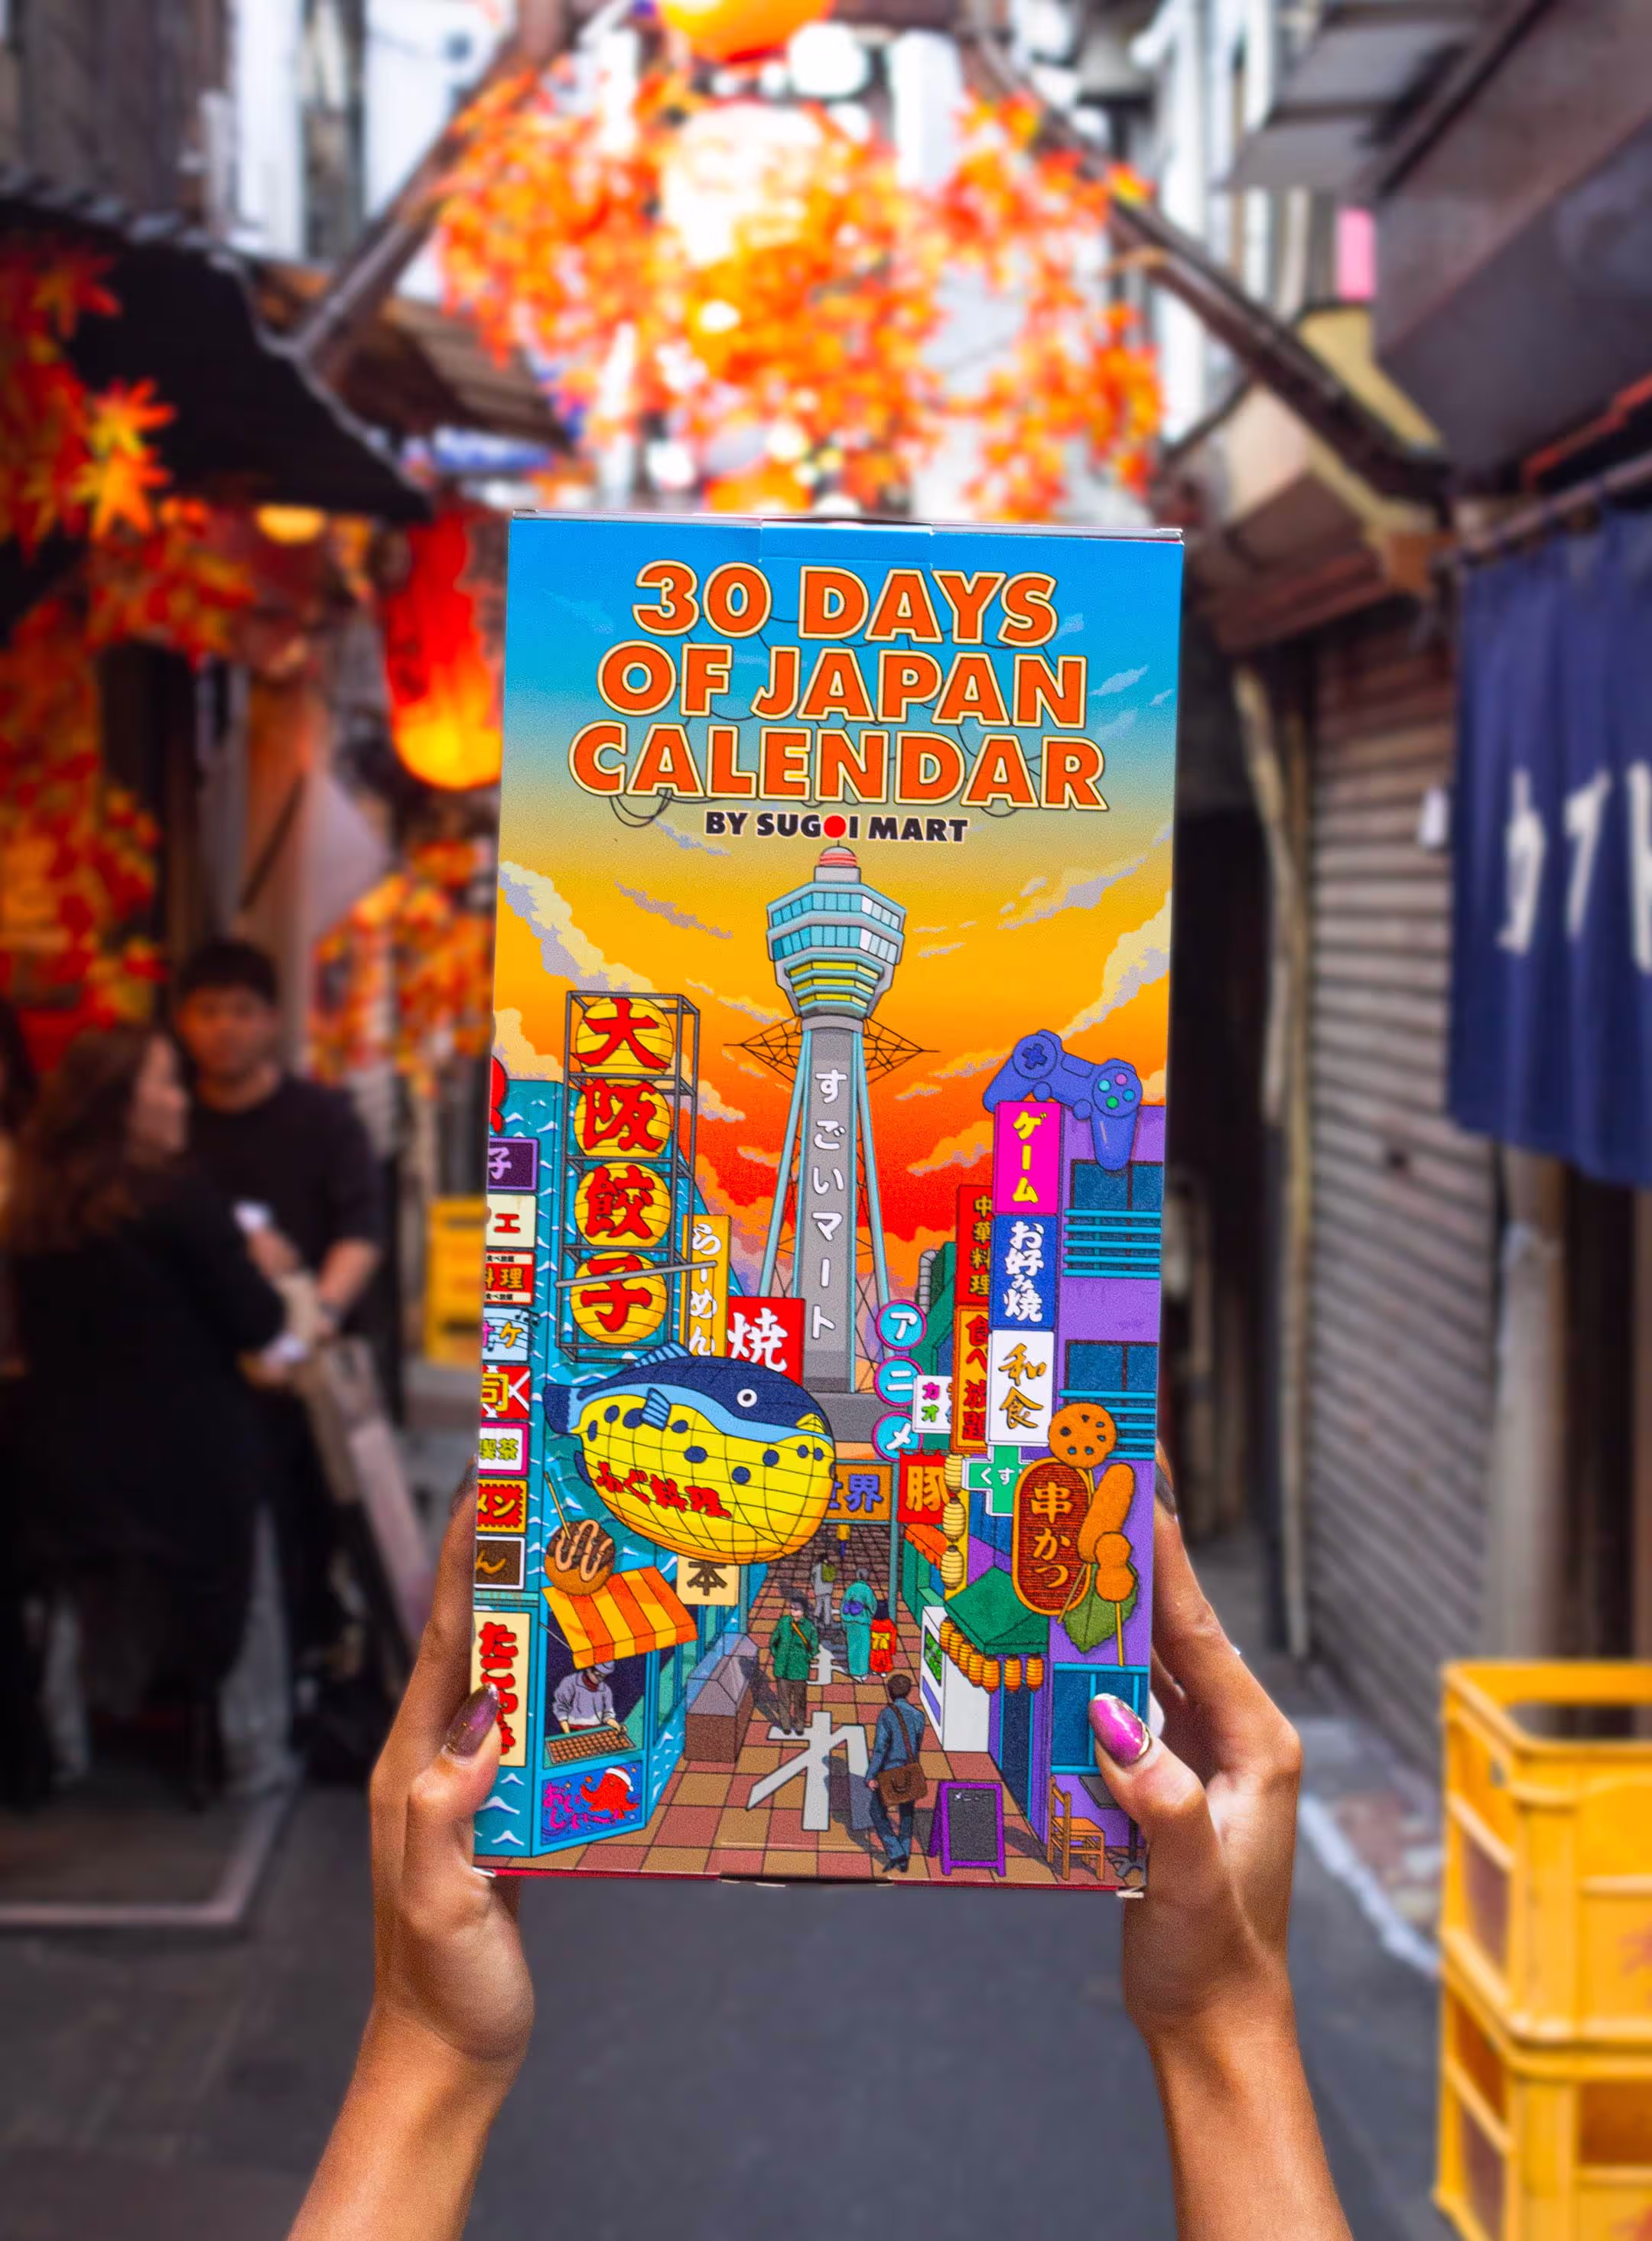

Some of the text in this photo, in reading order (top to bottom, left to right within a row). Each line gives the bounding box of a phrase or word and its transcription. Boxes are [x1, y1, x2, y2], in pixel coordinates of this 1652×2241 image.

[633, 560, 1059, 647] 30 DAYS
[597, 640, 1088, 729] OF JAPAN
[568, 720, 1110, 811] CALENDAR
[705, 811, 743, 836] BY
[869, 817, 969, 843] MART
[571, 997, 672, 1332] 大阪餃子
[1012, 1111, 1047, 1204] ゲーム
[812, 1068, 848, 1339] すごいマート
[1003, 1221, 1045, 1322] お好み焼
[727, 1307, 789, 1373] 焼
[998, 1342, 1047, 1430] 和食
[828, 1474, 883, 1513] 界
[980, 1467, 1023, 1486] くす
[1031, 1481, 1074, 1588] 串かつ
